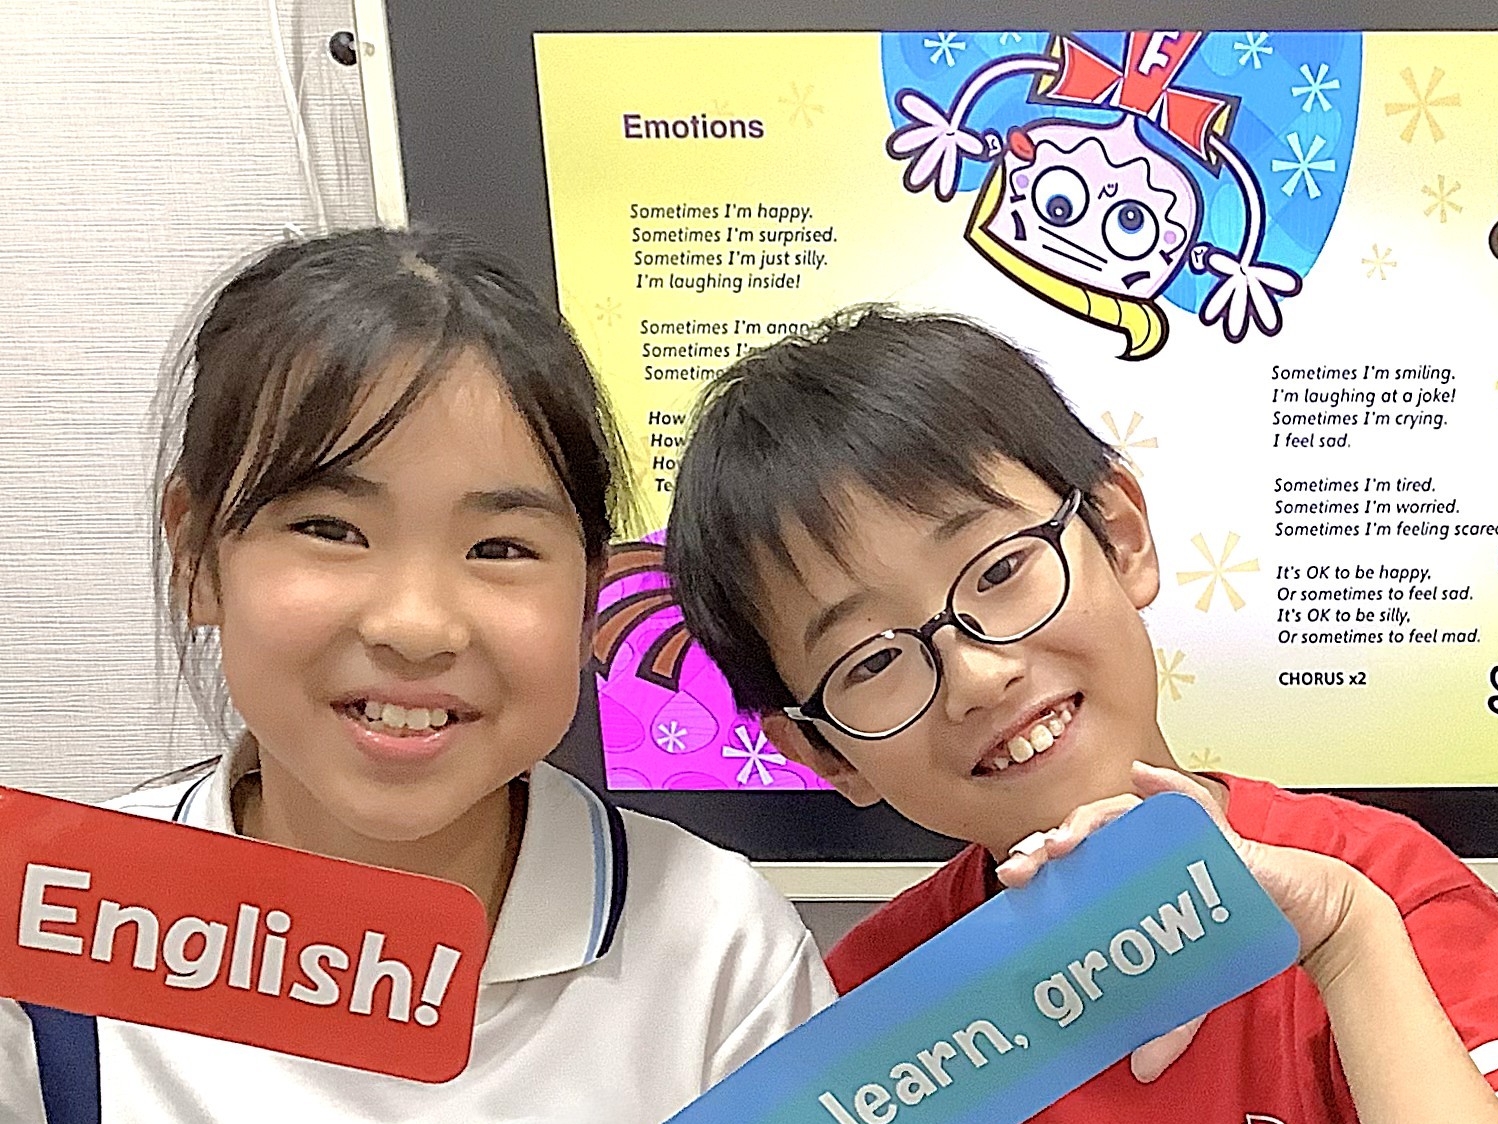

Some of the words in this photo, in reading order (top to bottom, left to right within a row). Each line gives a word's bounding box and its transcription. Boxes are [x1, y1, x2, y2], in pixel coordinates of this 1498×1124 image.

[1137, 30, 1180, 76] F
[622, 112, 765, 140] Emotions
[629, 202, 719, 220] Sometimes
[723, 202, 752, 219] I'm
[757, 202, 813, 224] happy.
[631, 226, 721, 243] Sometimes
[726, 226, 754, 243] I'm
[758, 225, 838, 247] surprised.
[633, 249, 723, 266] Sometimes
[727, 250, 756, 266] I'm
[758, 249, 791, 271] just
[794, 249, 828, 271] silly.
[635, 273, 664, 289] I'm
[669, 272, 743, 294] laughing
[747, 272, 801, 289] inside!
[639, 319, 729, 335] Sometimes
[733, 319, 761, 335] I'm
[641, 342, 731, 358] Sometimes
[1271, 364, 1358, 381] Sometimes
[1362, 365, 1390, 380] I'm
[1394, 364, 1456, 385] smiling.
[1271, 388, 1299, 403] I'm
[1304, 387, 1376, 408] laughing
[1380, 388, 1398, 404] at
[1402, 391, 1413, 403] a
[1414, 387, 1457, 408] joke!
[648, 410, 687, 426] How
[1272, 410, 1359, 426] Sometimes
[1363, 410, 1391, 426] I'm
[1395, 410, 1448, 430] crying.
[1272, 433, 1281, 448] I
[1285, 432, 1315, 448] feel
[1318, 432, 1351, 448] sad.
[652, 455, 680, 471] Ho
[1273, 477, 1360, 493] Sometimes
[1363, 477, 1391, 493] I'm
[1396, 476, 1436, 493] tired.
[1274, 499, 1360, 515] Sometimes
[1364, 499, 1391, 514] I'm
[1396, 498, 1460, 514] worried.
[1274, 521, 1360, 537] Sometimes
[1364, 521, 1392, 536] I'm
[1396, 520, 1450, 541] feeling
[1275, 565, 1301, 580] It's
[1306, 565, 1331, 580] OK
[1334, 565, 1351, 580] to
[1354, 564, 1375, 580] be
[1378, 564, 1432, 584] happy,
[1277, 586, 1298, 602] Or
[1300, 586, 1384, 602] sometimes
[1388, 587, 1405, 601] to
[1408, 585, 1438, 601] feel
[1441, 585, 1474, 601] sad.
[1276, 607, 1302, 623] It's
[1307, 607, 1332, 623] OK
[1335, 608, 1352, 623] to
[1355, 607, 1375, 623] be
[1378, 606, 1411, 627] silly,
[1277, 629, 1299, 644] Or
[1300, 628, 1384, 644] sometimes
[1388, 629, 1405, 644] to
[1408, 628, 1438, 644] feel
[1441, 627, 1481, 643] mad.
[1278, 671, 1345, 687] CHORUS
[1348, 671, 1367, 686] x2
[17, 862, 462, 1027] English!
[1033, 859, 1232, 1029] grow!
